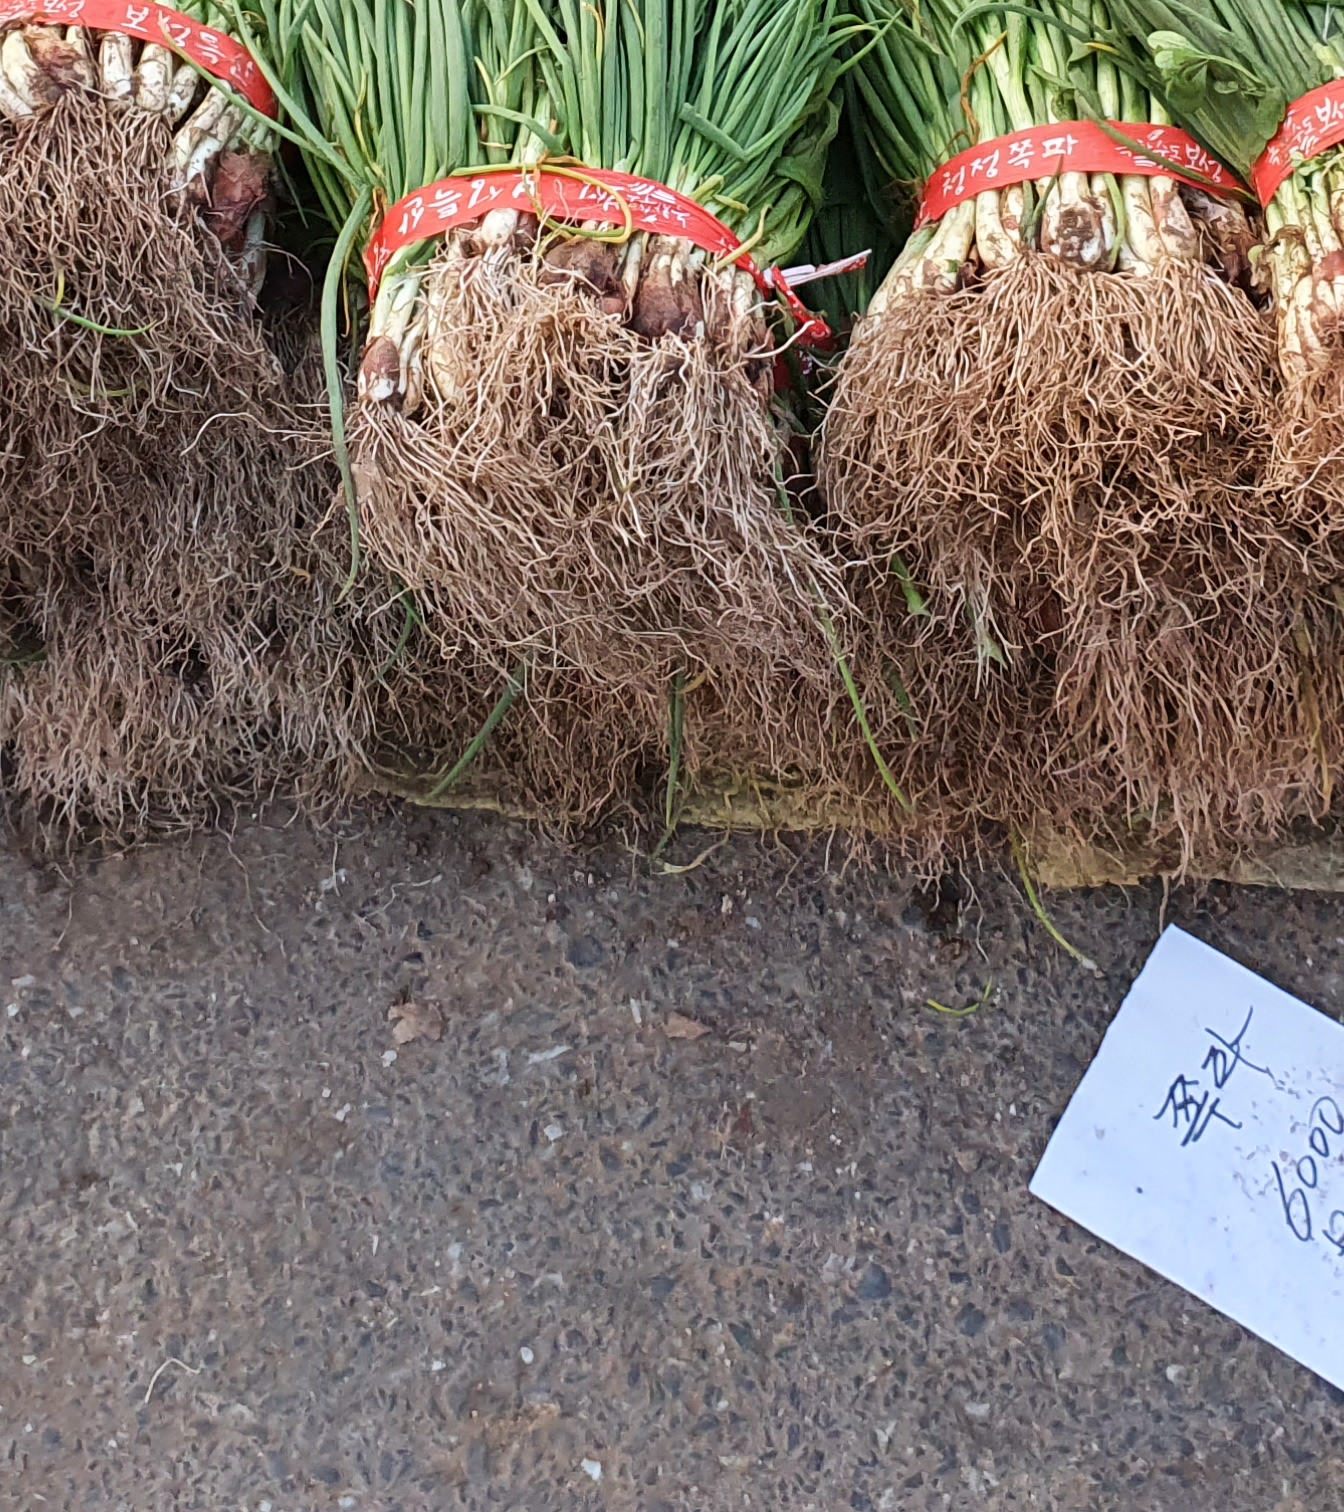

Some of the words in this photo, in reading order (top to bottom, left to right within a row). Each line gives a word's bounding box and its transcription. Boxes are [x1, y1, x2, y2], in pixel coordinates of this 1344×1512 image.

[121, 2, 256, 87] 보성특산
[940, 134, 1080, 198] 청정쪽파
[1184, 142, 1224, 183] 보성
[1152, 1006, 1273, 1147] 쪽파
